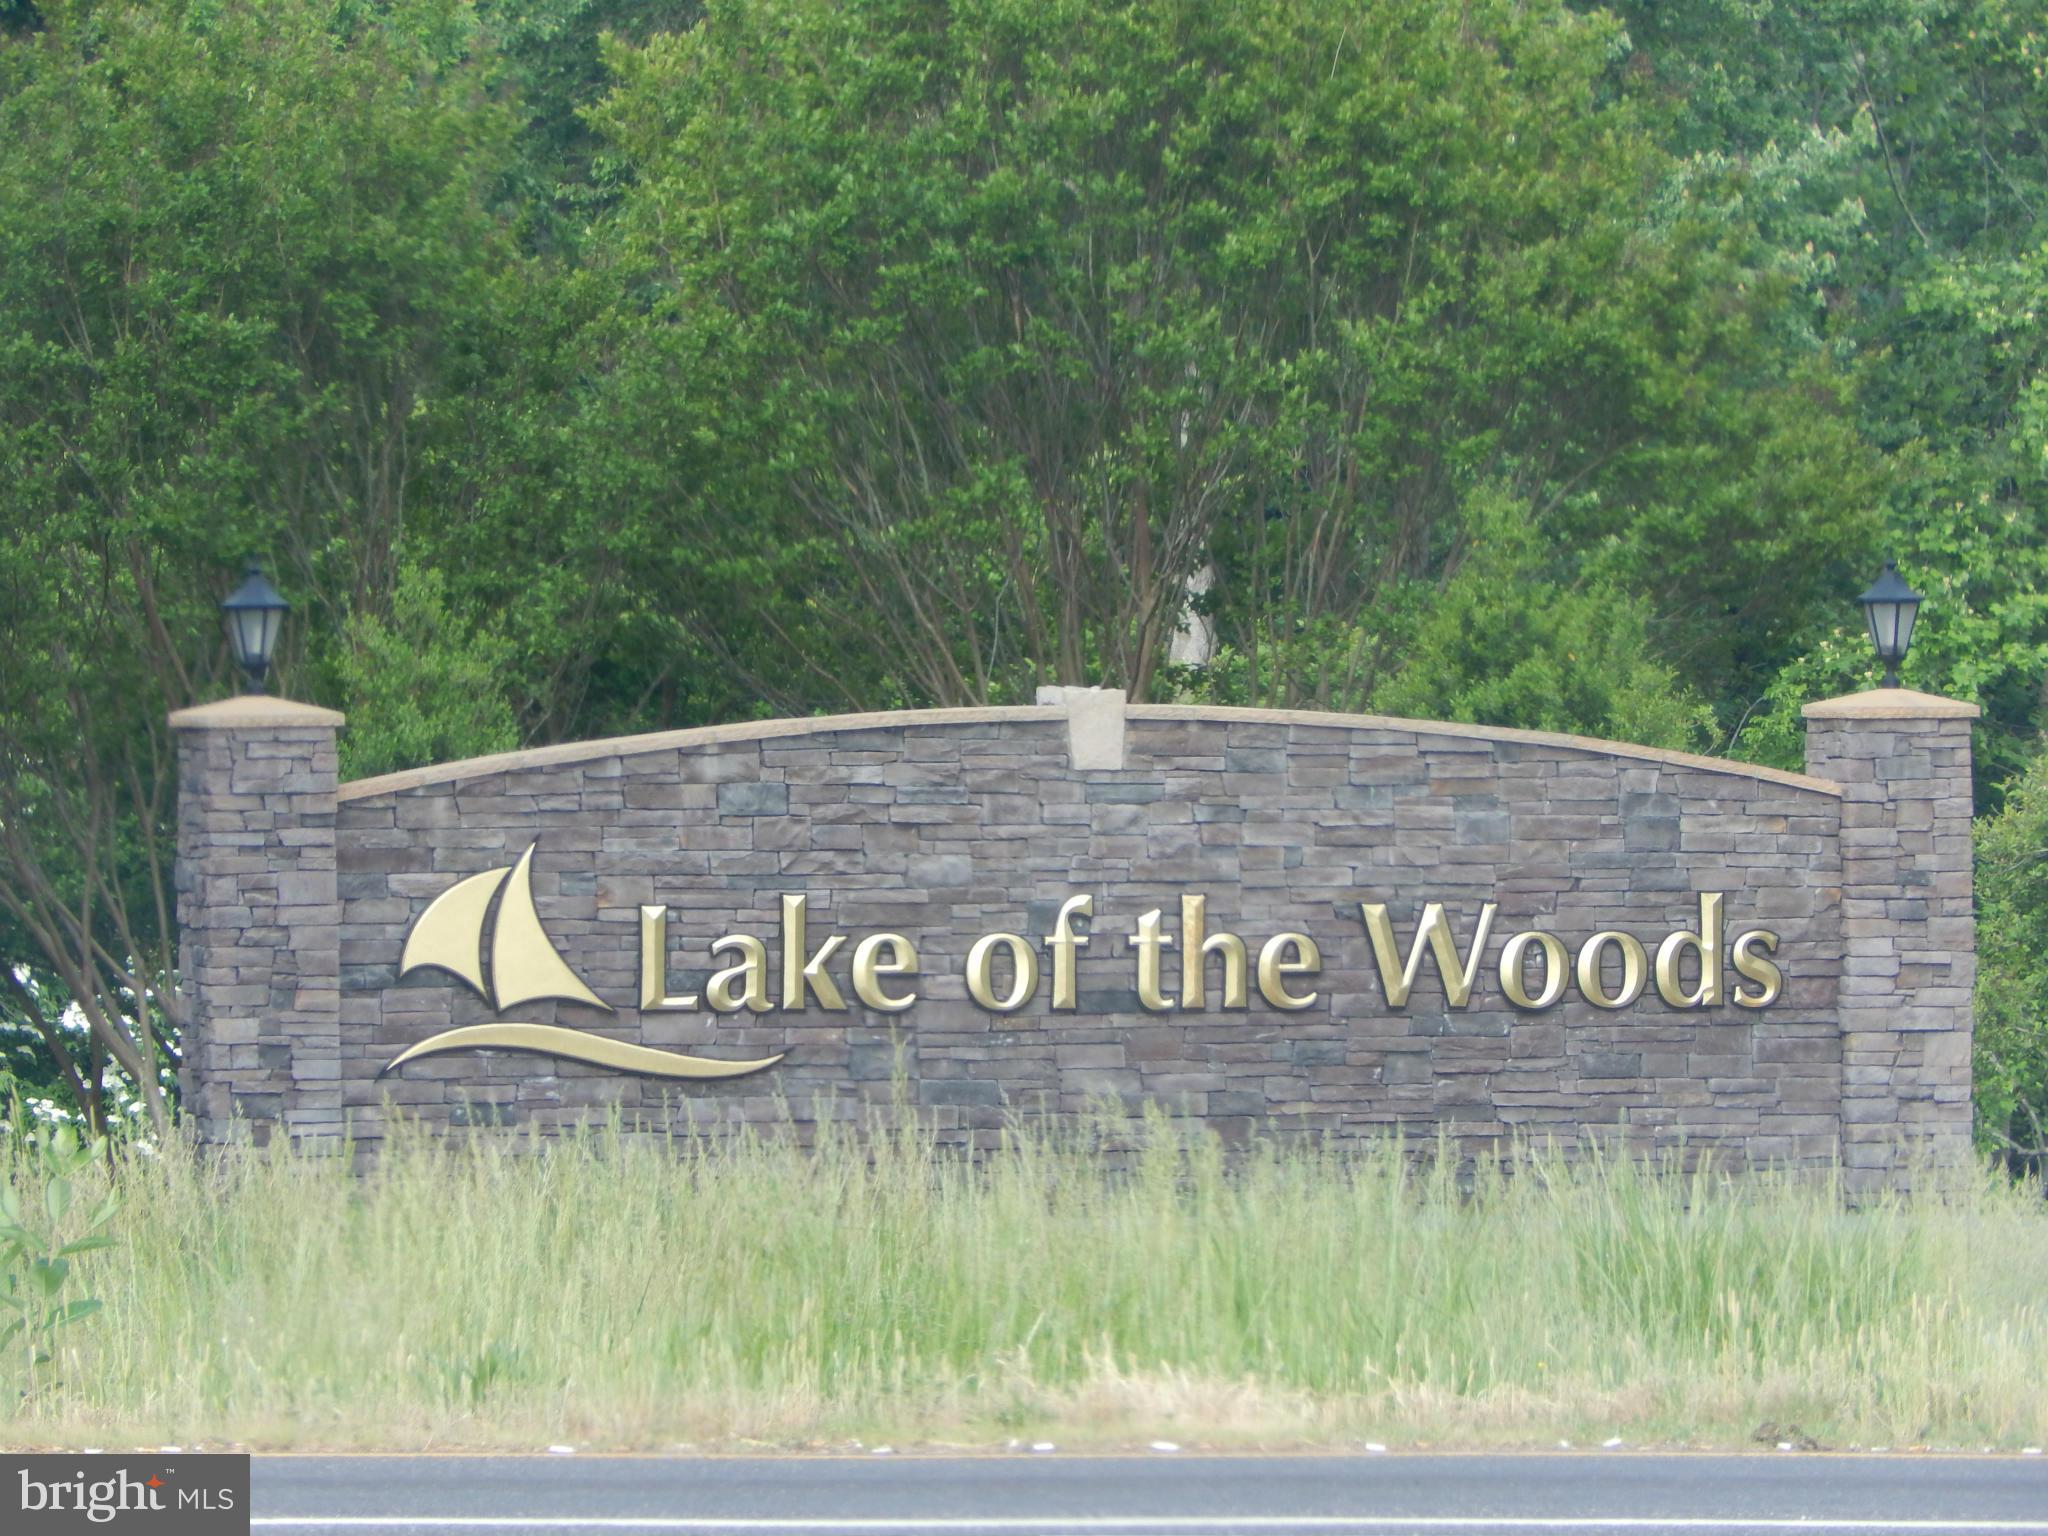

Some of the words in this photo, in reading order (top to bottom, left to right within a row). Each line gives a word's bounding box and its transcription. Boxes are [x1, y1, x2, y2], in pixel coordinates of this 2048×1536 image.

[639, 893, 919, 1012] Lake
[965, 893, 1095, 1012] of
[1128, 893, 1321, 1012] the
[1360, 891, 1784, 1011] Woods
